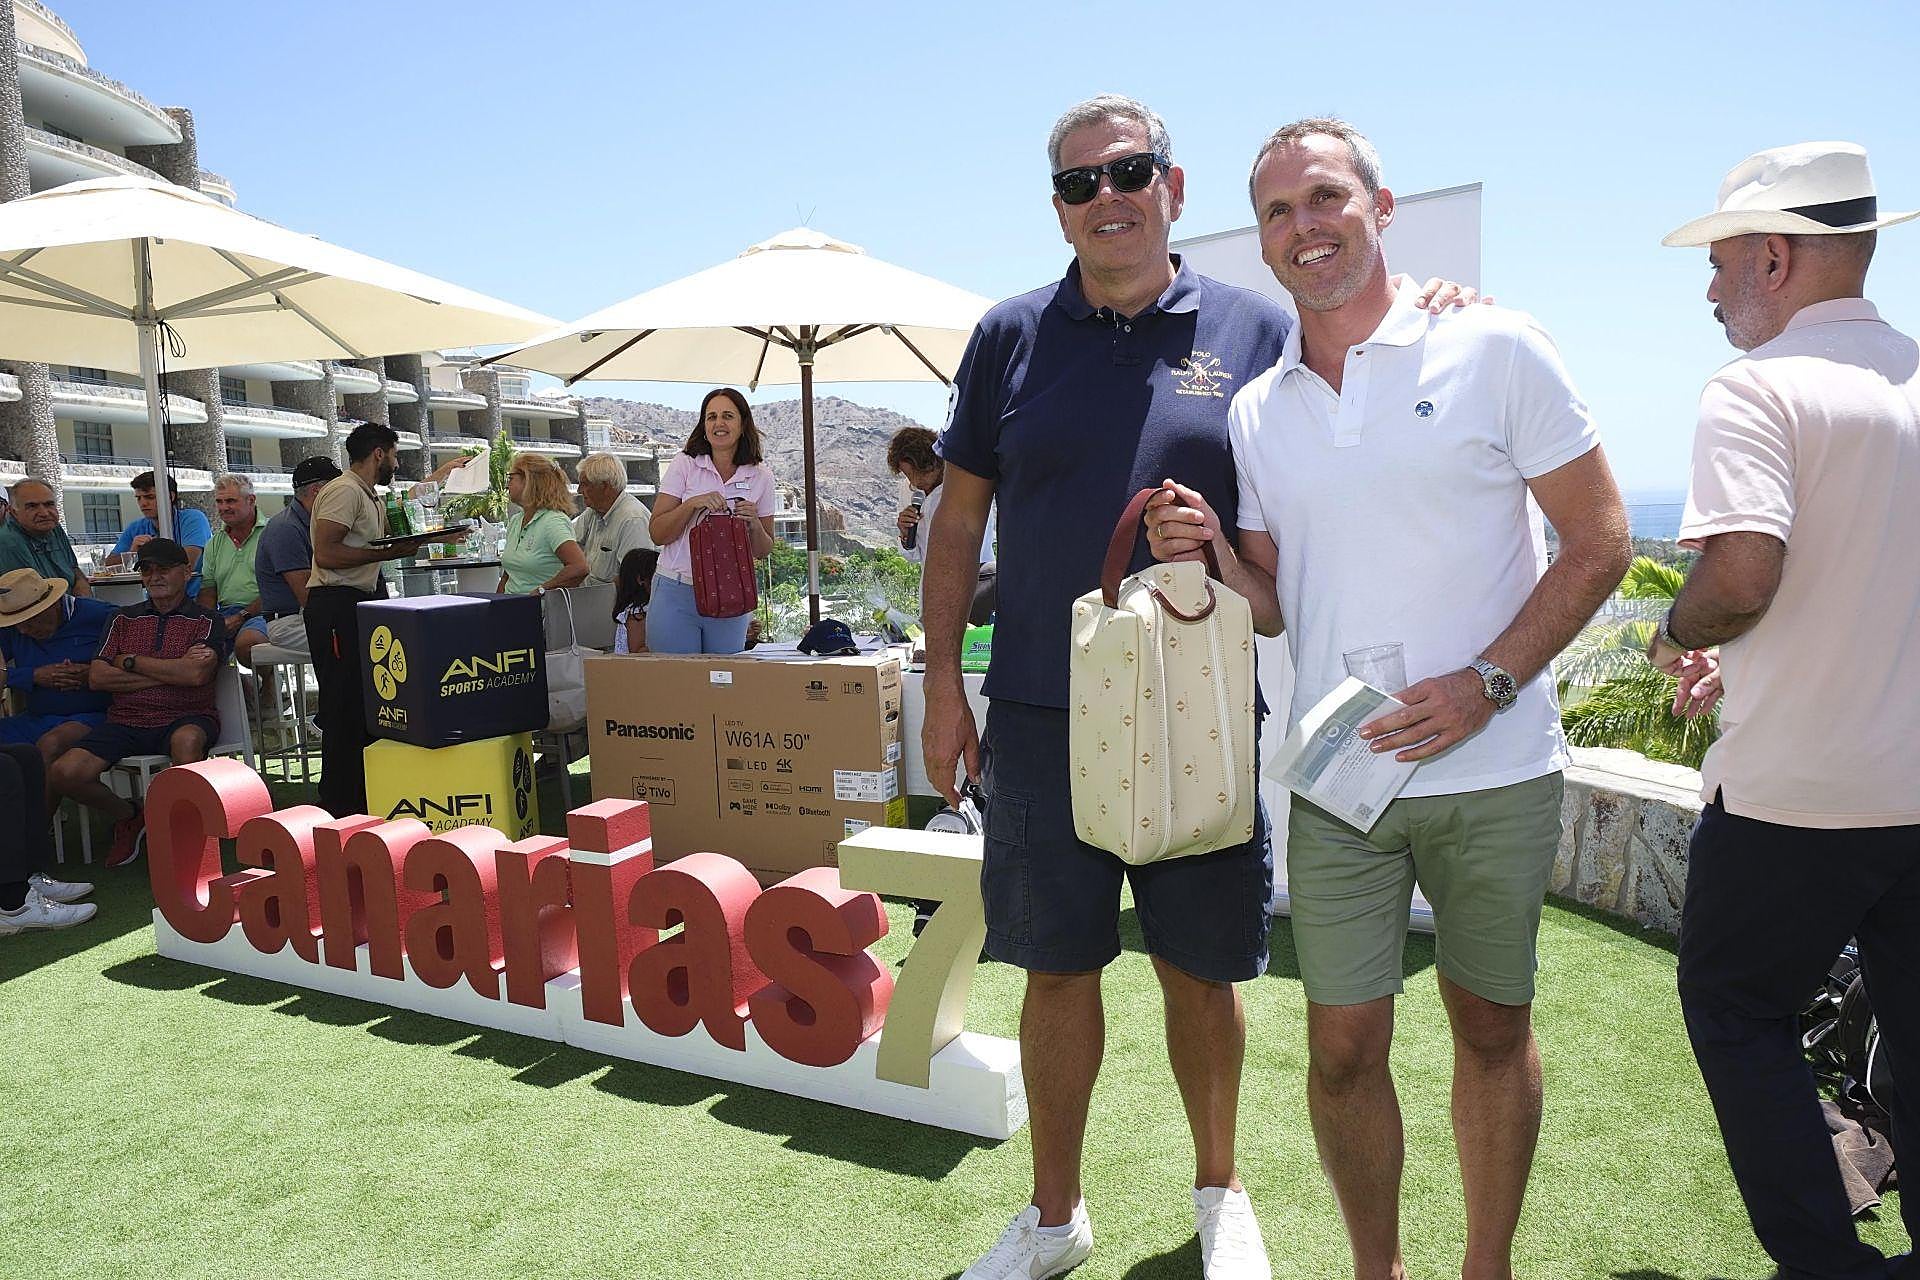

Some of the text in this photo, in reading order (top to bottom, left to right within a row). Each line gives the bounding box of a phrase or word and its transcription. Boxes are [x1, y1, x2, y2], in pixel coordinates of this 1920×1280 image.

[440, 648, 536, 683] ANFI
[440, 671, 537, 697] SPORTS ACADEMY
[378, 705, 408, 724] ANFI
[605, 719, 694, 741] Panasonic
[725, 730, 810, 751] W61A 50"
[747, 761, 768, 771] LED
[776, 758, 792, 769] 4K
[649, 786, 671, 799] TiVo
[385, 793, 493, 821] ANFI
[774, 802, 792, 813] Dolby
[805, 807, 832, 818] Bluetooth
